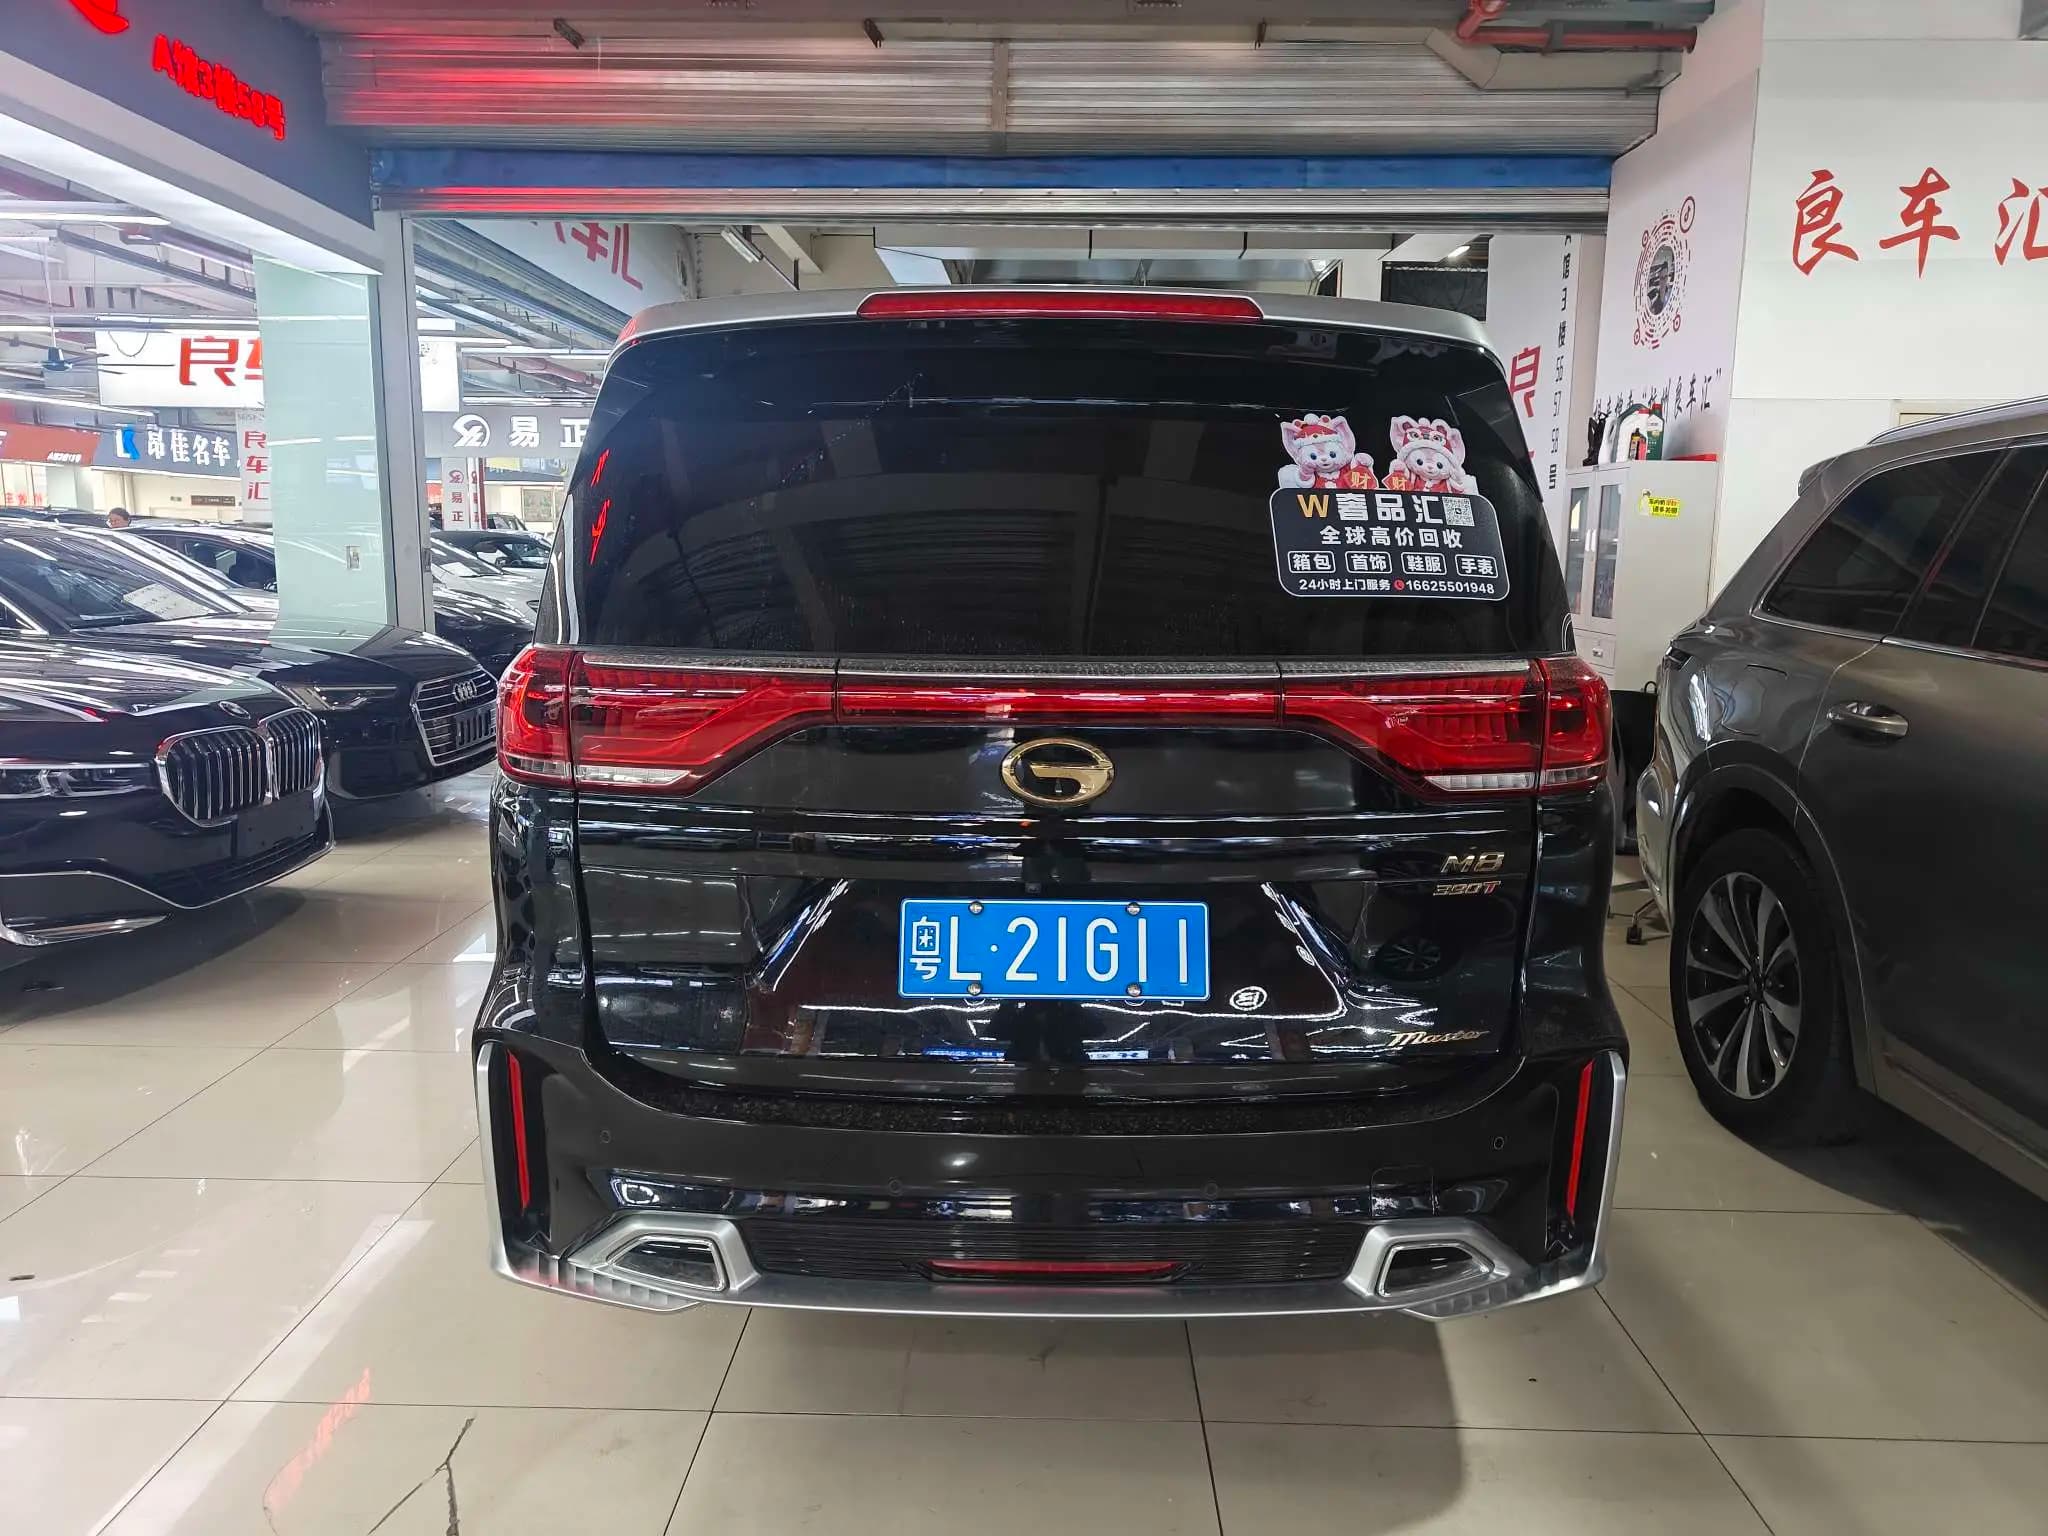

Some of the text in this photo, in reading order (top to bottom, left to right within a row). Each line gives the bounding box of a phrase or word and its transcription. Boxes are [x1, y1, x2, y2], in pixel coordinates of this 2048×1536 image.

[1792, 165, 2048, 279] 良车汇
[1350, 470, 1370, 489] 财
[1320, 525, 1463, 549] 全球高价回收
[1293, 554, 1495, 576] 箱包 首饰 鞋服 手表
[1299, 579, 1495, 594] 24小时上门服务 16625501948
[1440, 852, 1504, 873] M8
[1387, 1029, 1490, 1049] Master
